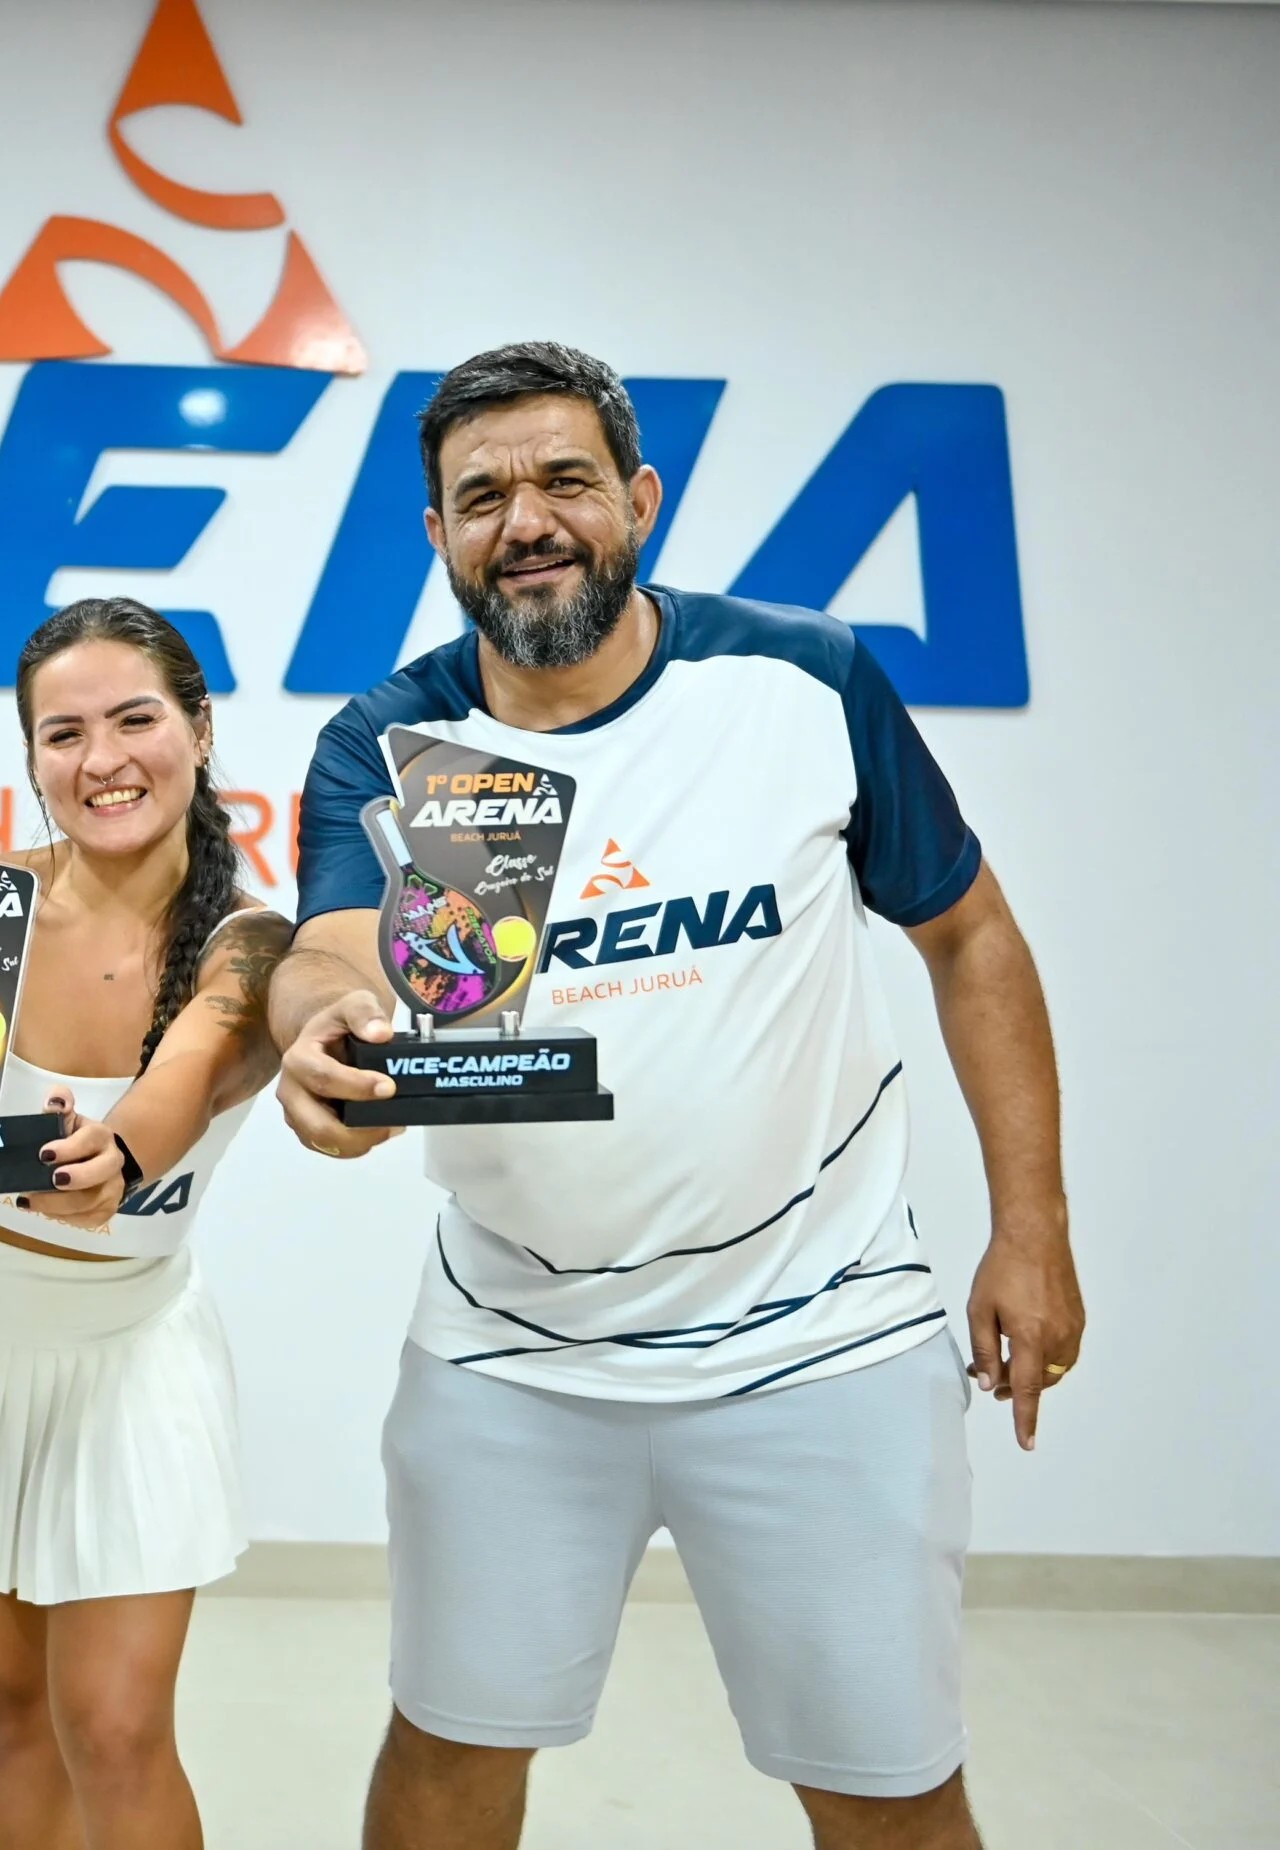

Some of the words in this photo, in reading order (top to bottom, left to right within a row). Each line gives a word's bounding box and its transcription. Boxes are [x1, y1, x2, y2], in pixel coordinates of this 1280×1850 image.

[450, 772, 535, 794] OPEN
[409, 797, 563, 827] ARENA
[450, 832, 484, 842] BEACH
[535, 883, 783, 974] RENA
[2, 956, 19, 971] Sul
[551, 981, 623, 1005] BEACH
[630, 965, 703, 995] JURUÁ
[386, 1048, 571, 1075] VICE-CAMPEÃO
[435, 1075, 523, 1087] MASCULINO
